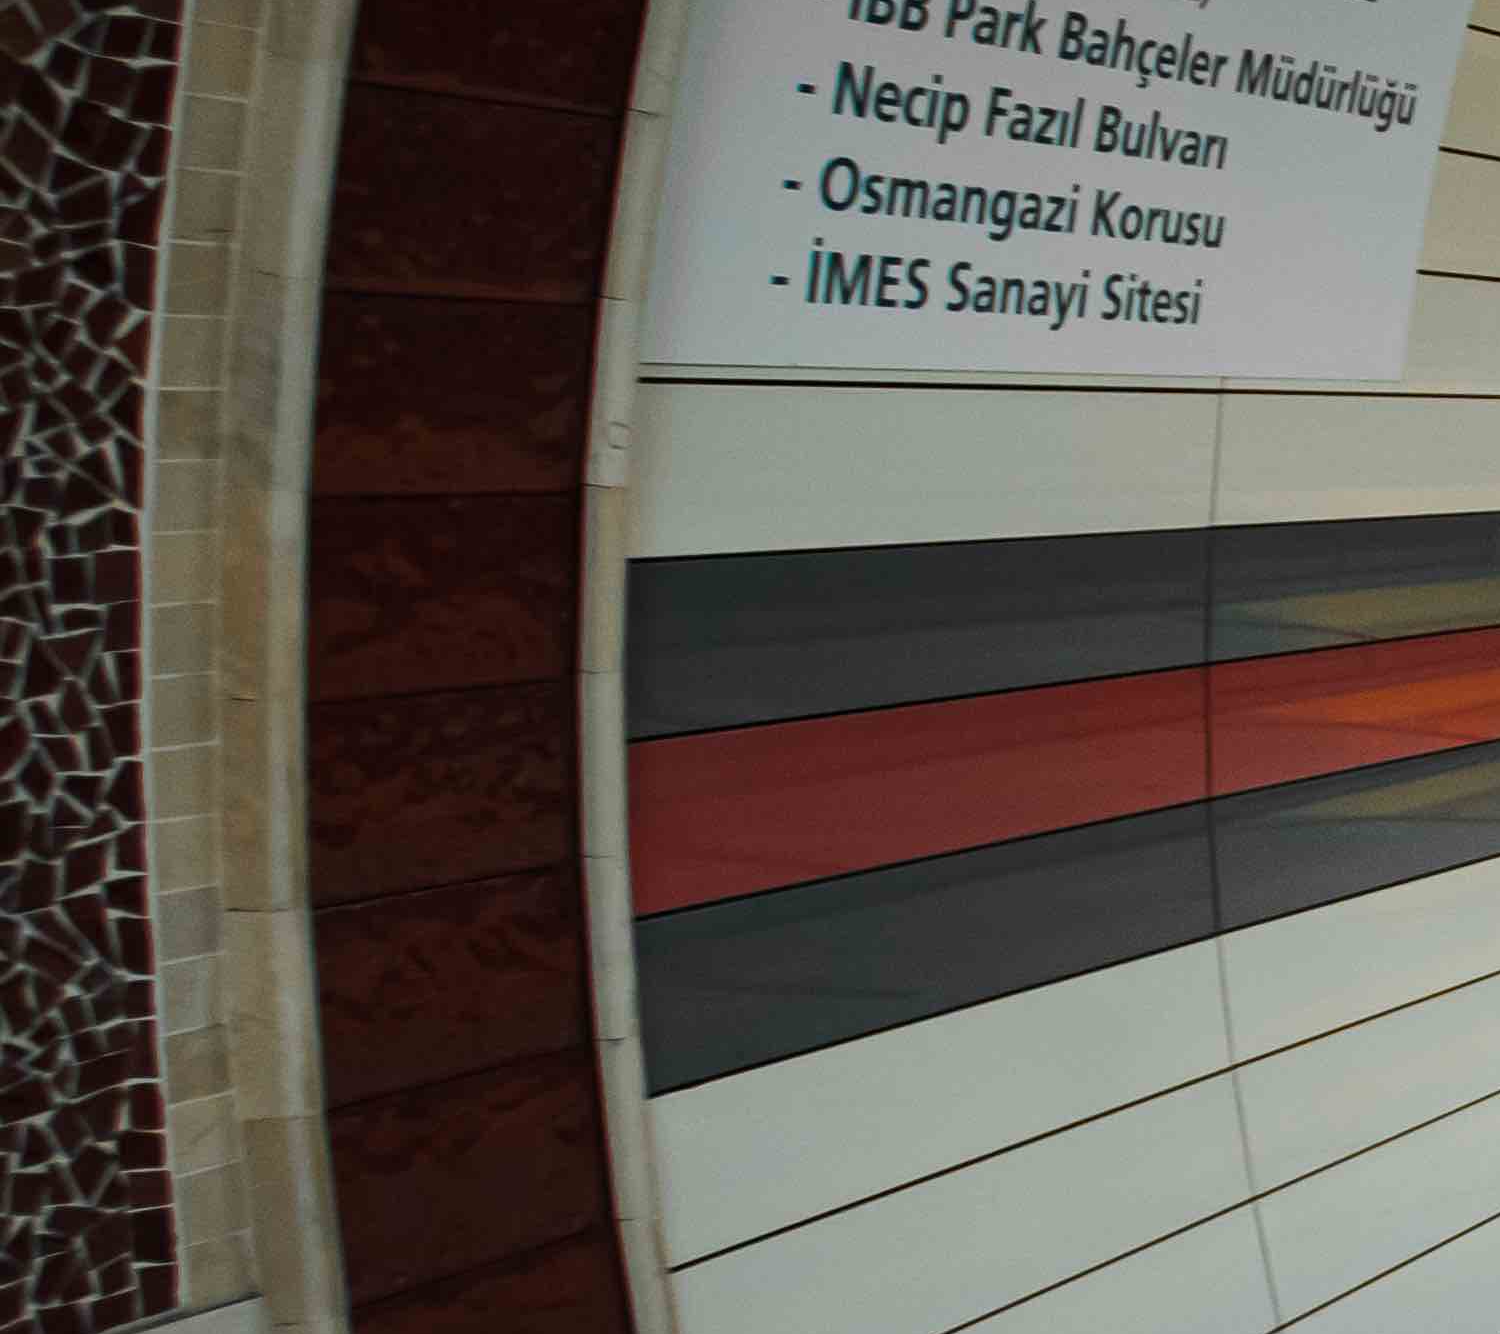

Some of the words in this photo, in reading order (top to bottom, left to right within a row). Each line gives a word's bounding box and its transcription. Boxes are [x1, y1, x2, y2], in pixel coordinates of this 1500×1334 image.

[831, 62, 970, 144] Necip
[984, 87, 1085, 149] Fazıl
[1094, 104, 1227, 168] Bulvarı
[1059, 11, 1227, 88] Bahçeler
[1235, 49, 1418, 132] Müdürlüğü
[820, 157, 1080, 241] Osmangazi
[1090, 189, 1224, 249] Korusu
[806, 237, 930, 309] İMES
[945, 261, 1090, 330] Sanayi
[1101, 274, 1203, 324] Sitesi
